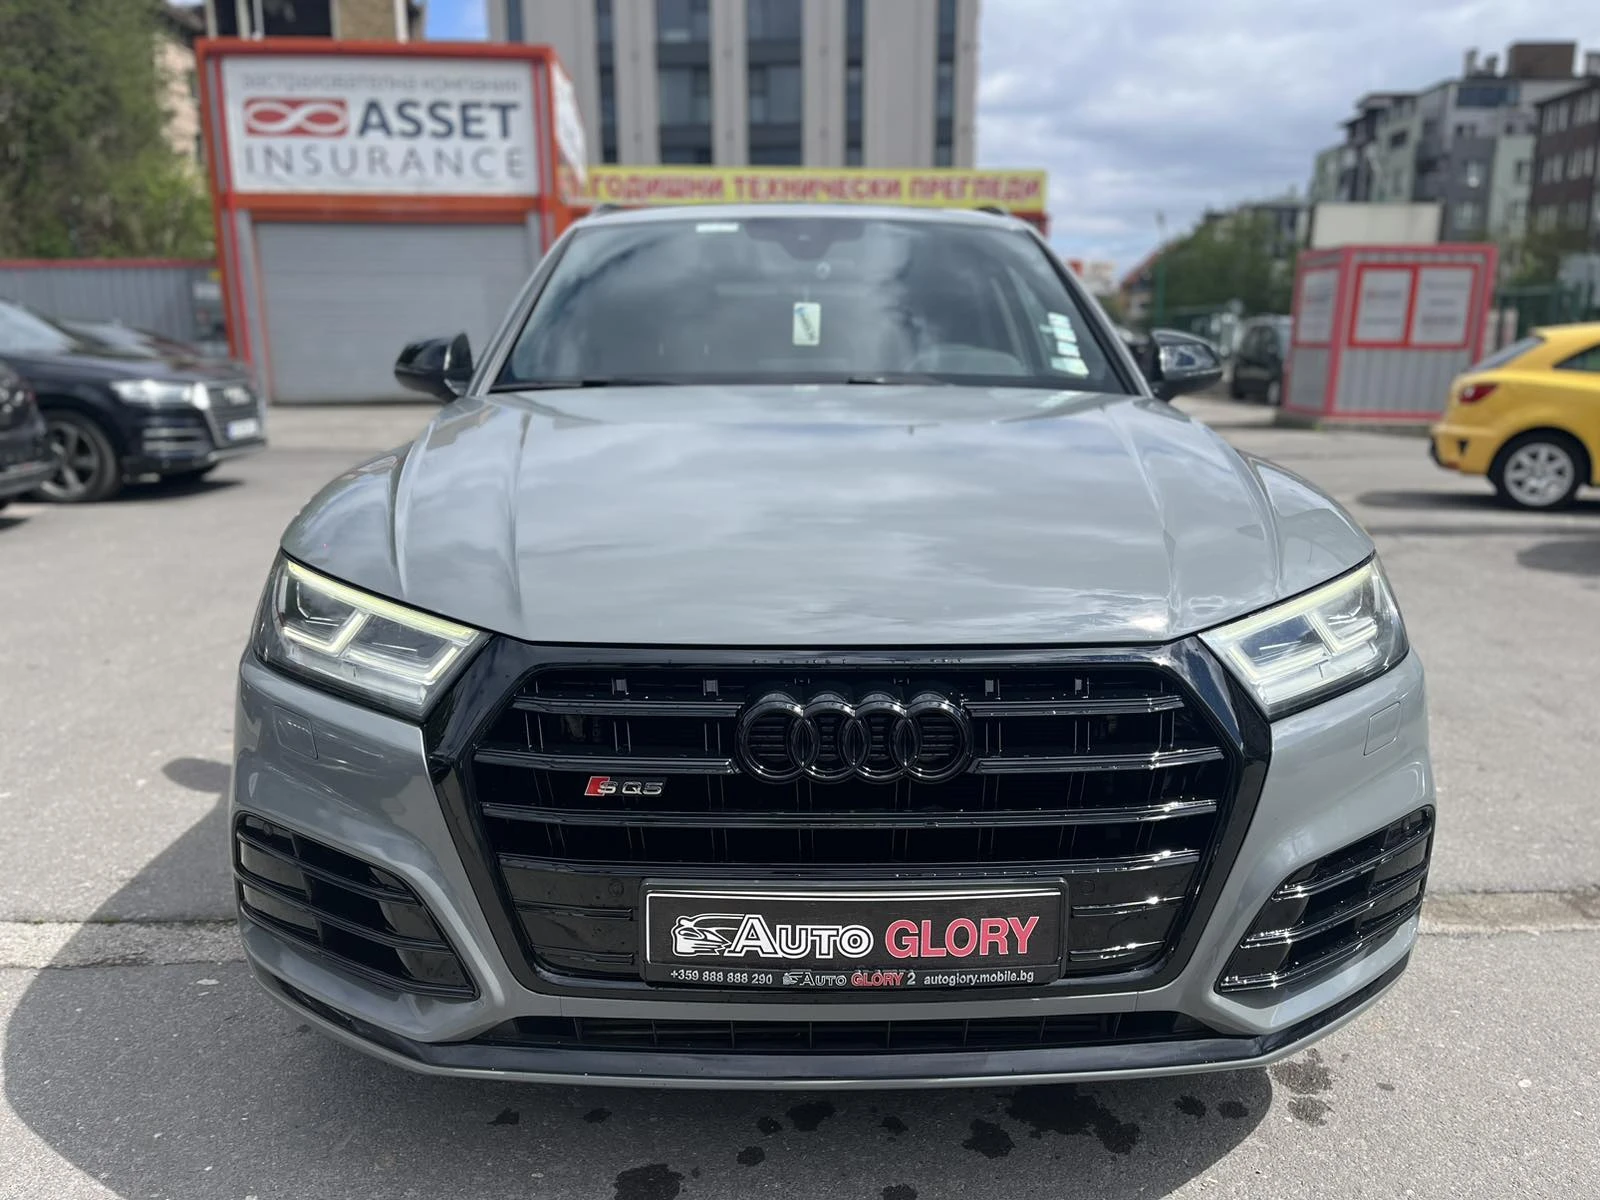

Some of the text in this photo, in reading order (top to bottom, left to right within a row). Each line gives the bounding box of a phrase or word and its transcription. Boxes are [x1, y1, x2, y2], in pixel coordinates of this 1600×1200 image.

[357, 98, 520, 140] ASSET
[246, 145, 527, 180] INSURANCE
[734, 173, 902, 201] ТЕХНИЧЕСКИ
[909, 173, 1041, 203] ПРЕГЛЕДИ
[597, 781, 664, 795] SQ5
[885, 915, 1040, 959] GLORY
[670, 969, 699, 981] +359
[702, 971, 724, 983] 888
[727, 973, 749, 984] 888
[751, 973, 773, 985] 290
[851, 971, 904, 987] GLORY
[907, 973, 916, 986] 2
[923, 970, 1034, 986] autoglory.mobile.bg
